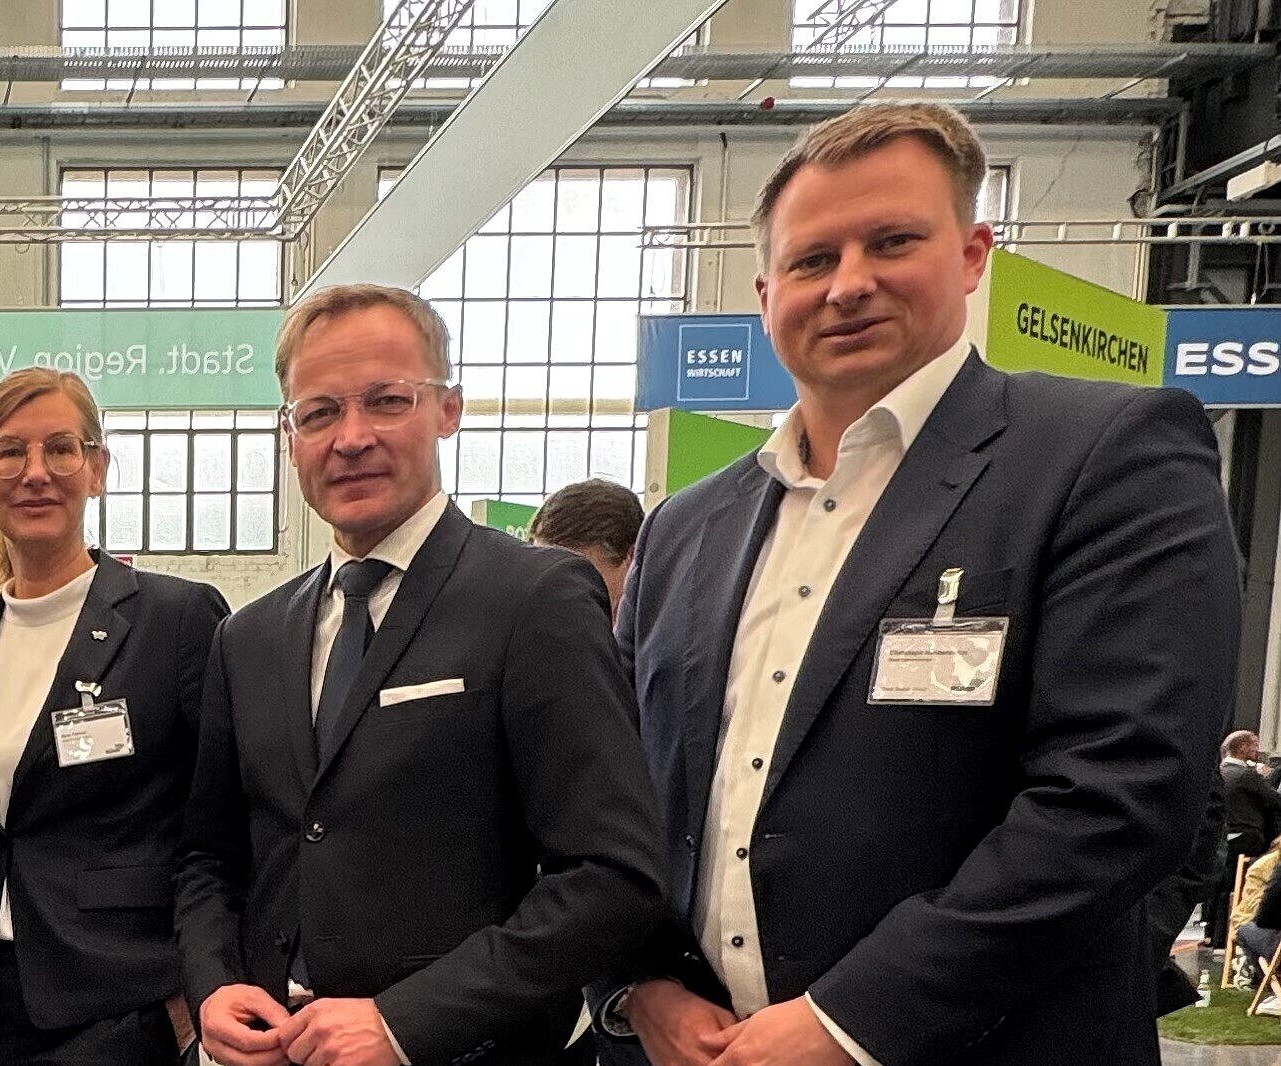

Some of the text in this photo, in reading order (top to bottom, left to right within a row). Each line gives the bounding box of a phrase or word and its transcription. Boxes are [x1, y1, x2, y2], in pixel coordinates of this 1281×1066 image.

[1017, 302, 1149, 374] GELSENKIRCHEN
[687, 349, 743, 364] ESSEN
[1175, 341, 1279, 376] ESS
[686, 367, 742, 378] WIRTSCHAFT
